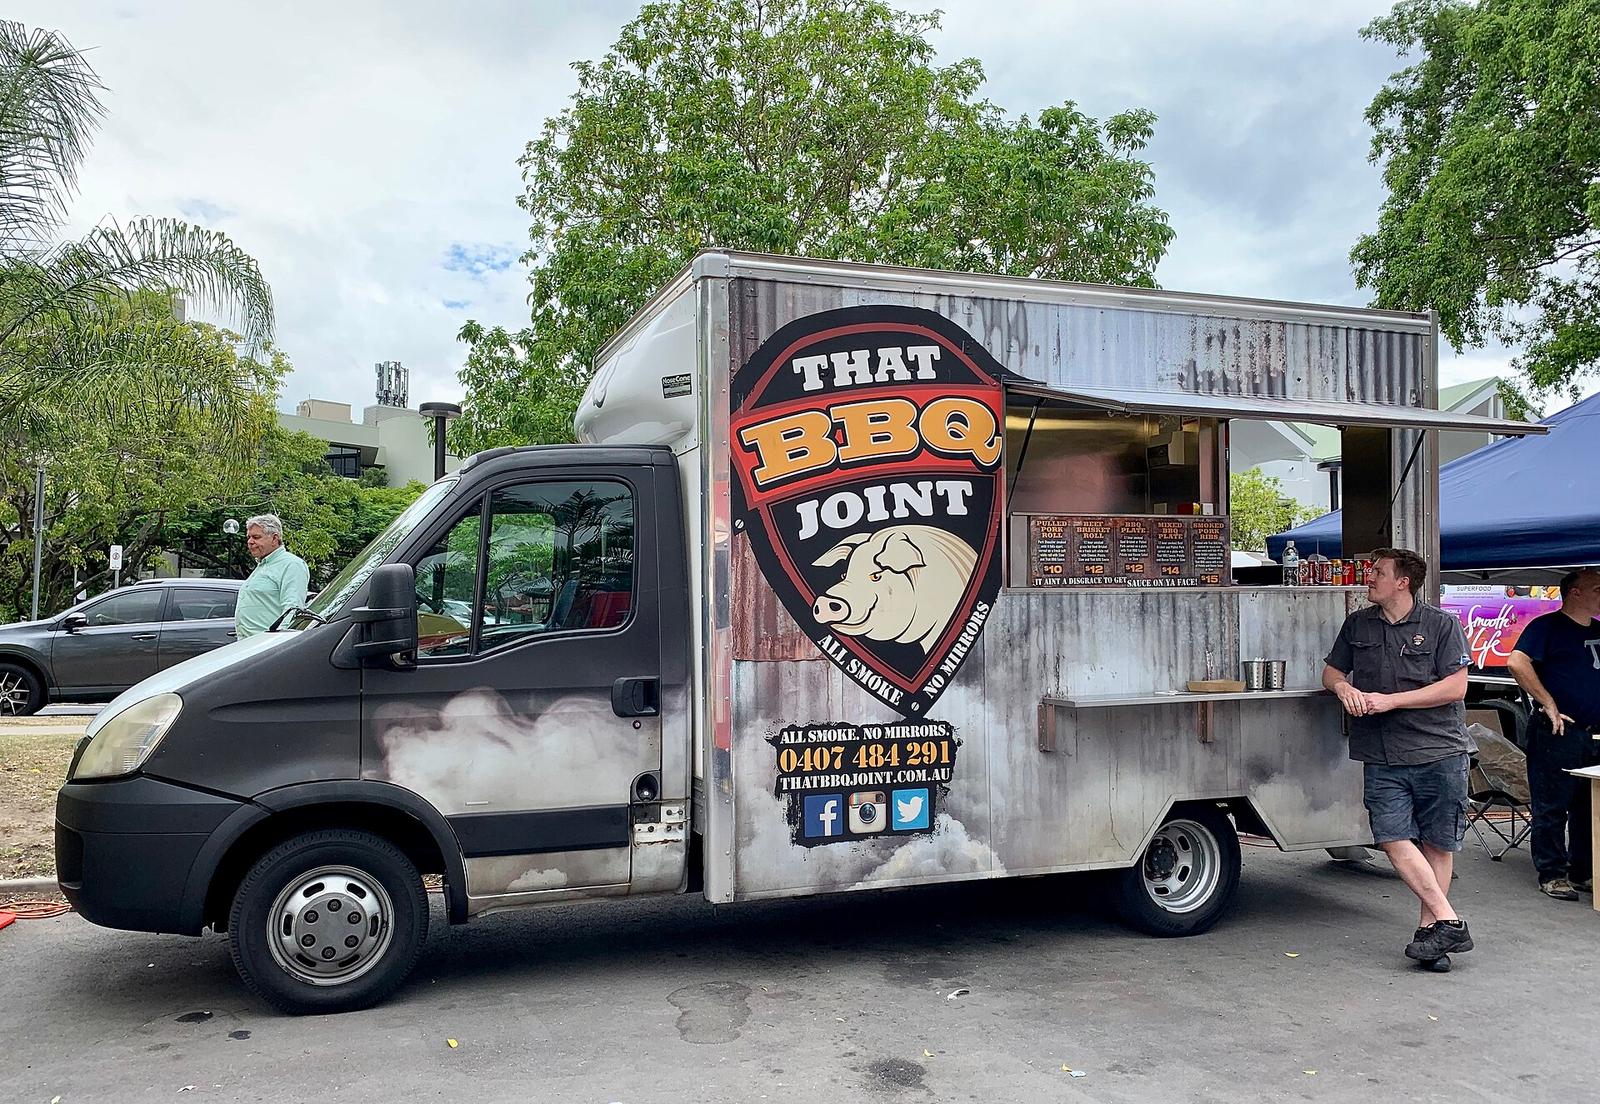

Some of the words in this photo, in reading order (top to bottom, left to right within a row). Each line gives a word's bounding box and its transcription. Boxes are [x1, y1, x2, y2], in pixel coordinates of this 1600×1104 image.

[792, 345, 941, 392] THAT
[741, 398, 1002, 486] BBQ
[796, 480, 973, 540] JOINT
[1043, 565, 1063, 574] $10
[1044, 577, 1060, 585] AINT
[1103, 576, 1113, 584] TO
[1114, 576, 1127, 584] GET
[1127, 579, 1151, 587] SAUCE
[1153, 579, 1165, 587] ON
[1165, 578, 1176, 586] YA
[1177, 578, 1198, 586] FACE!
[1085, 565, 1104, 574] $12
[1125, 564, 1144, 573] $12
[1162, 566, 1180, 575] $14
[1200, 575, 1219, 583] $15
[1464, 604, 1512, 639] Smooth
[922, 674, 945, 699] NO
[940, 600, 990, 677] MIRRORS
[1471, 628, 1511, 669] Life
[817, 634, 848, 665] ALL
[846, 658, 904, 706] SMOKE
[780, 729, 807, 744] ALL
[808, 728, 860, 744] SMOKE.
[863, 727, 882, 740] NO
[884, 724, 950, 739] MIRRORS.
[780, 746, 845, 773] 0407
[852, 743, 900, 769] 484
[906, 740, 951, 765] 291
[780, 768, 950, 790] THATBBQJOINT.COM.AU
